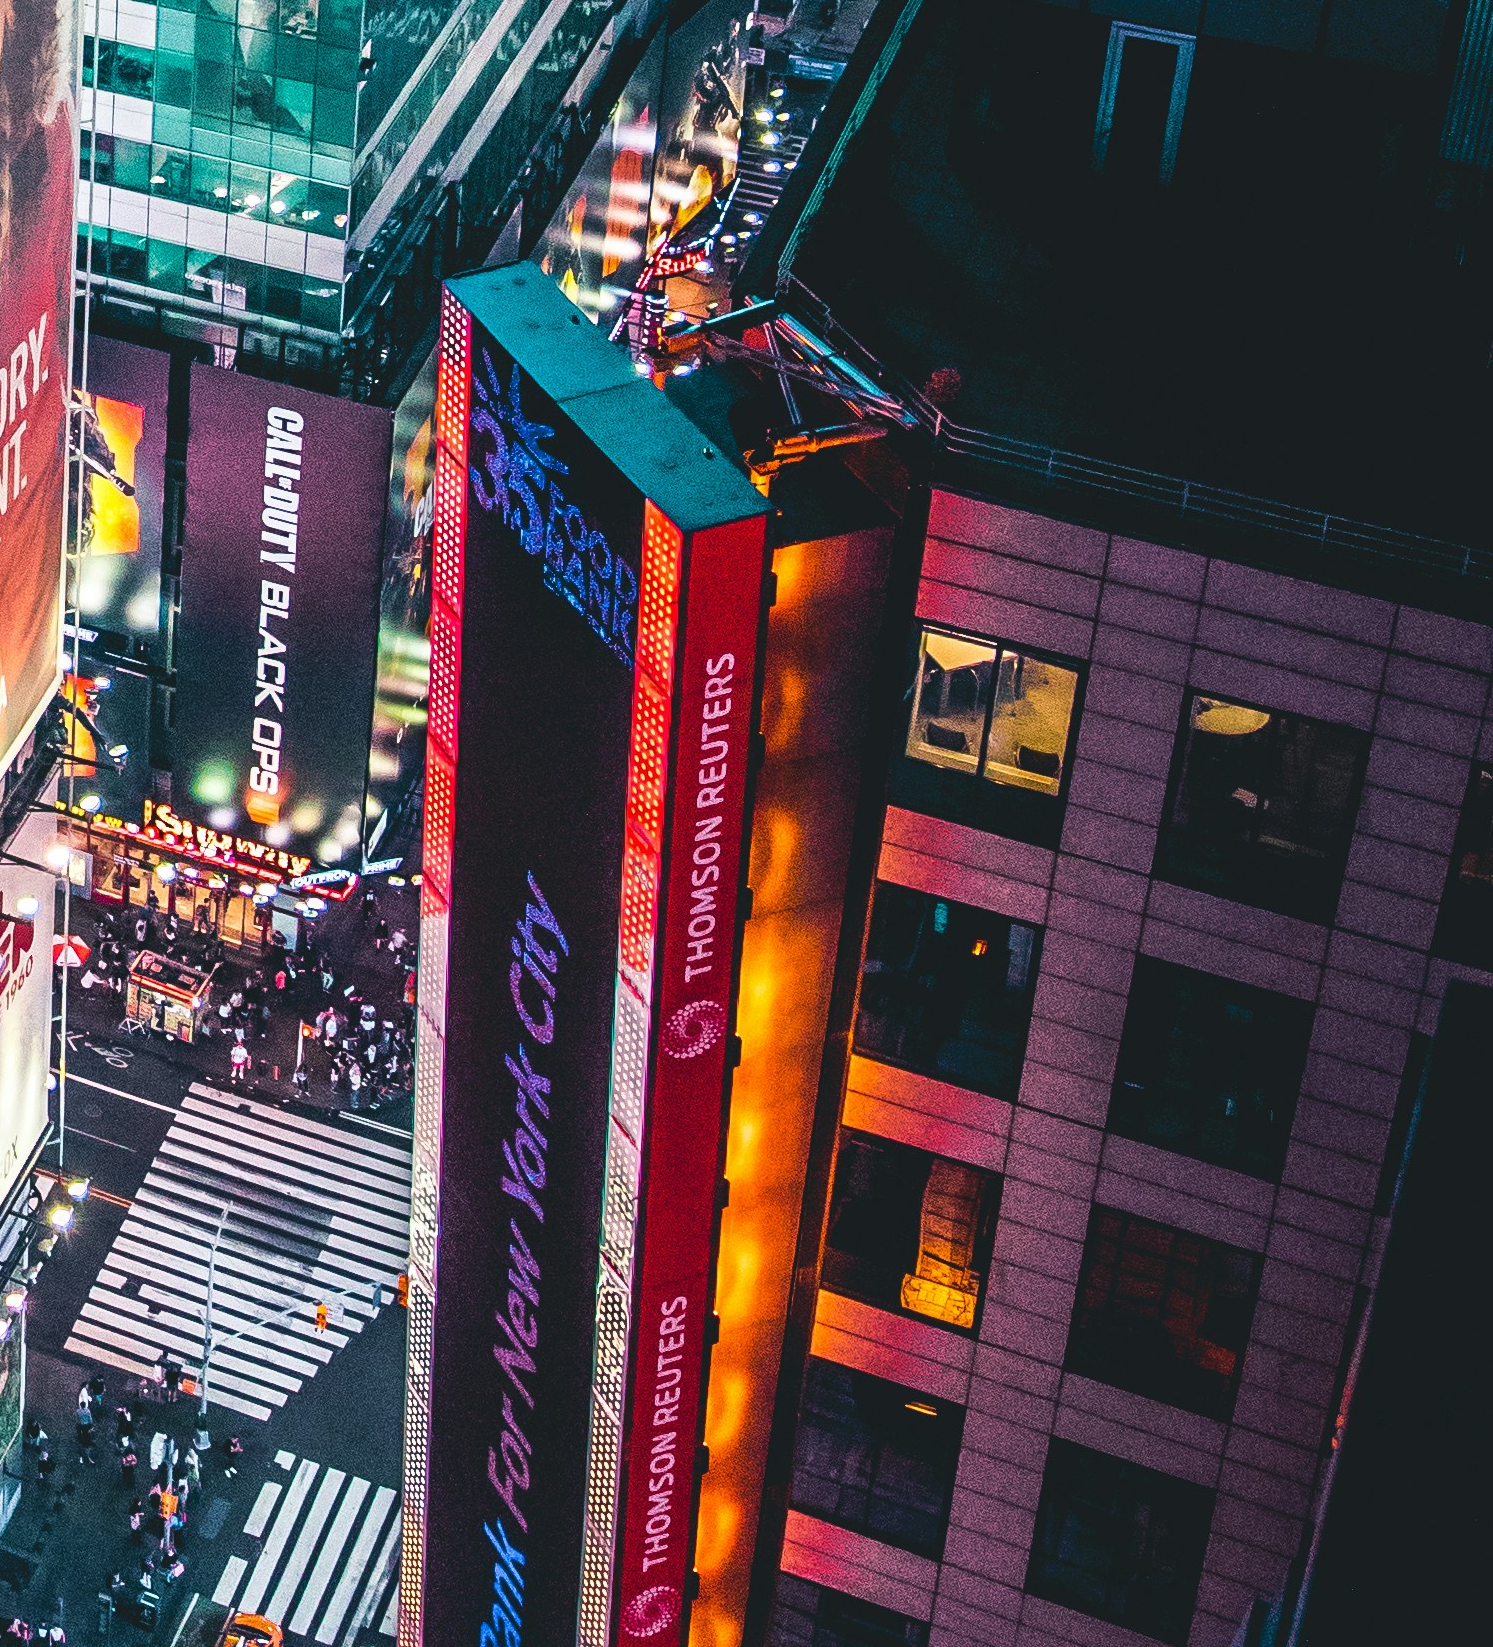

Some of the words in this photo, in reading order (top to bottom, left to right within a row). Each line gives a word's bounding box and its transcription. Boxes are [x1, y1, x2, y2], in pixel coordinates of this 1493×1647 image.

[266, 405, 305, 477] CALL
[259, 483, 301, 575] DUTY
[254, 579, 292, 714] BLACK
[249, 716, 283, 797] OPS
[694, 651, 735, 813] REUTERS
[507, 870, 571, 1046] City
[684, 815, 725, 984] THOMSON
[0, 957, 37, 1018] 1960
[500, 1043, 552, 1223] York
[493, 1217, 541, 1381] New
[652, 1293, 689, 1430] REUTERS
[641, 1433, 678, 1575] THOMSON
